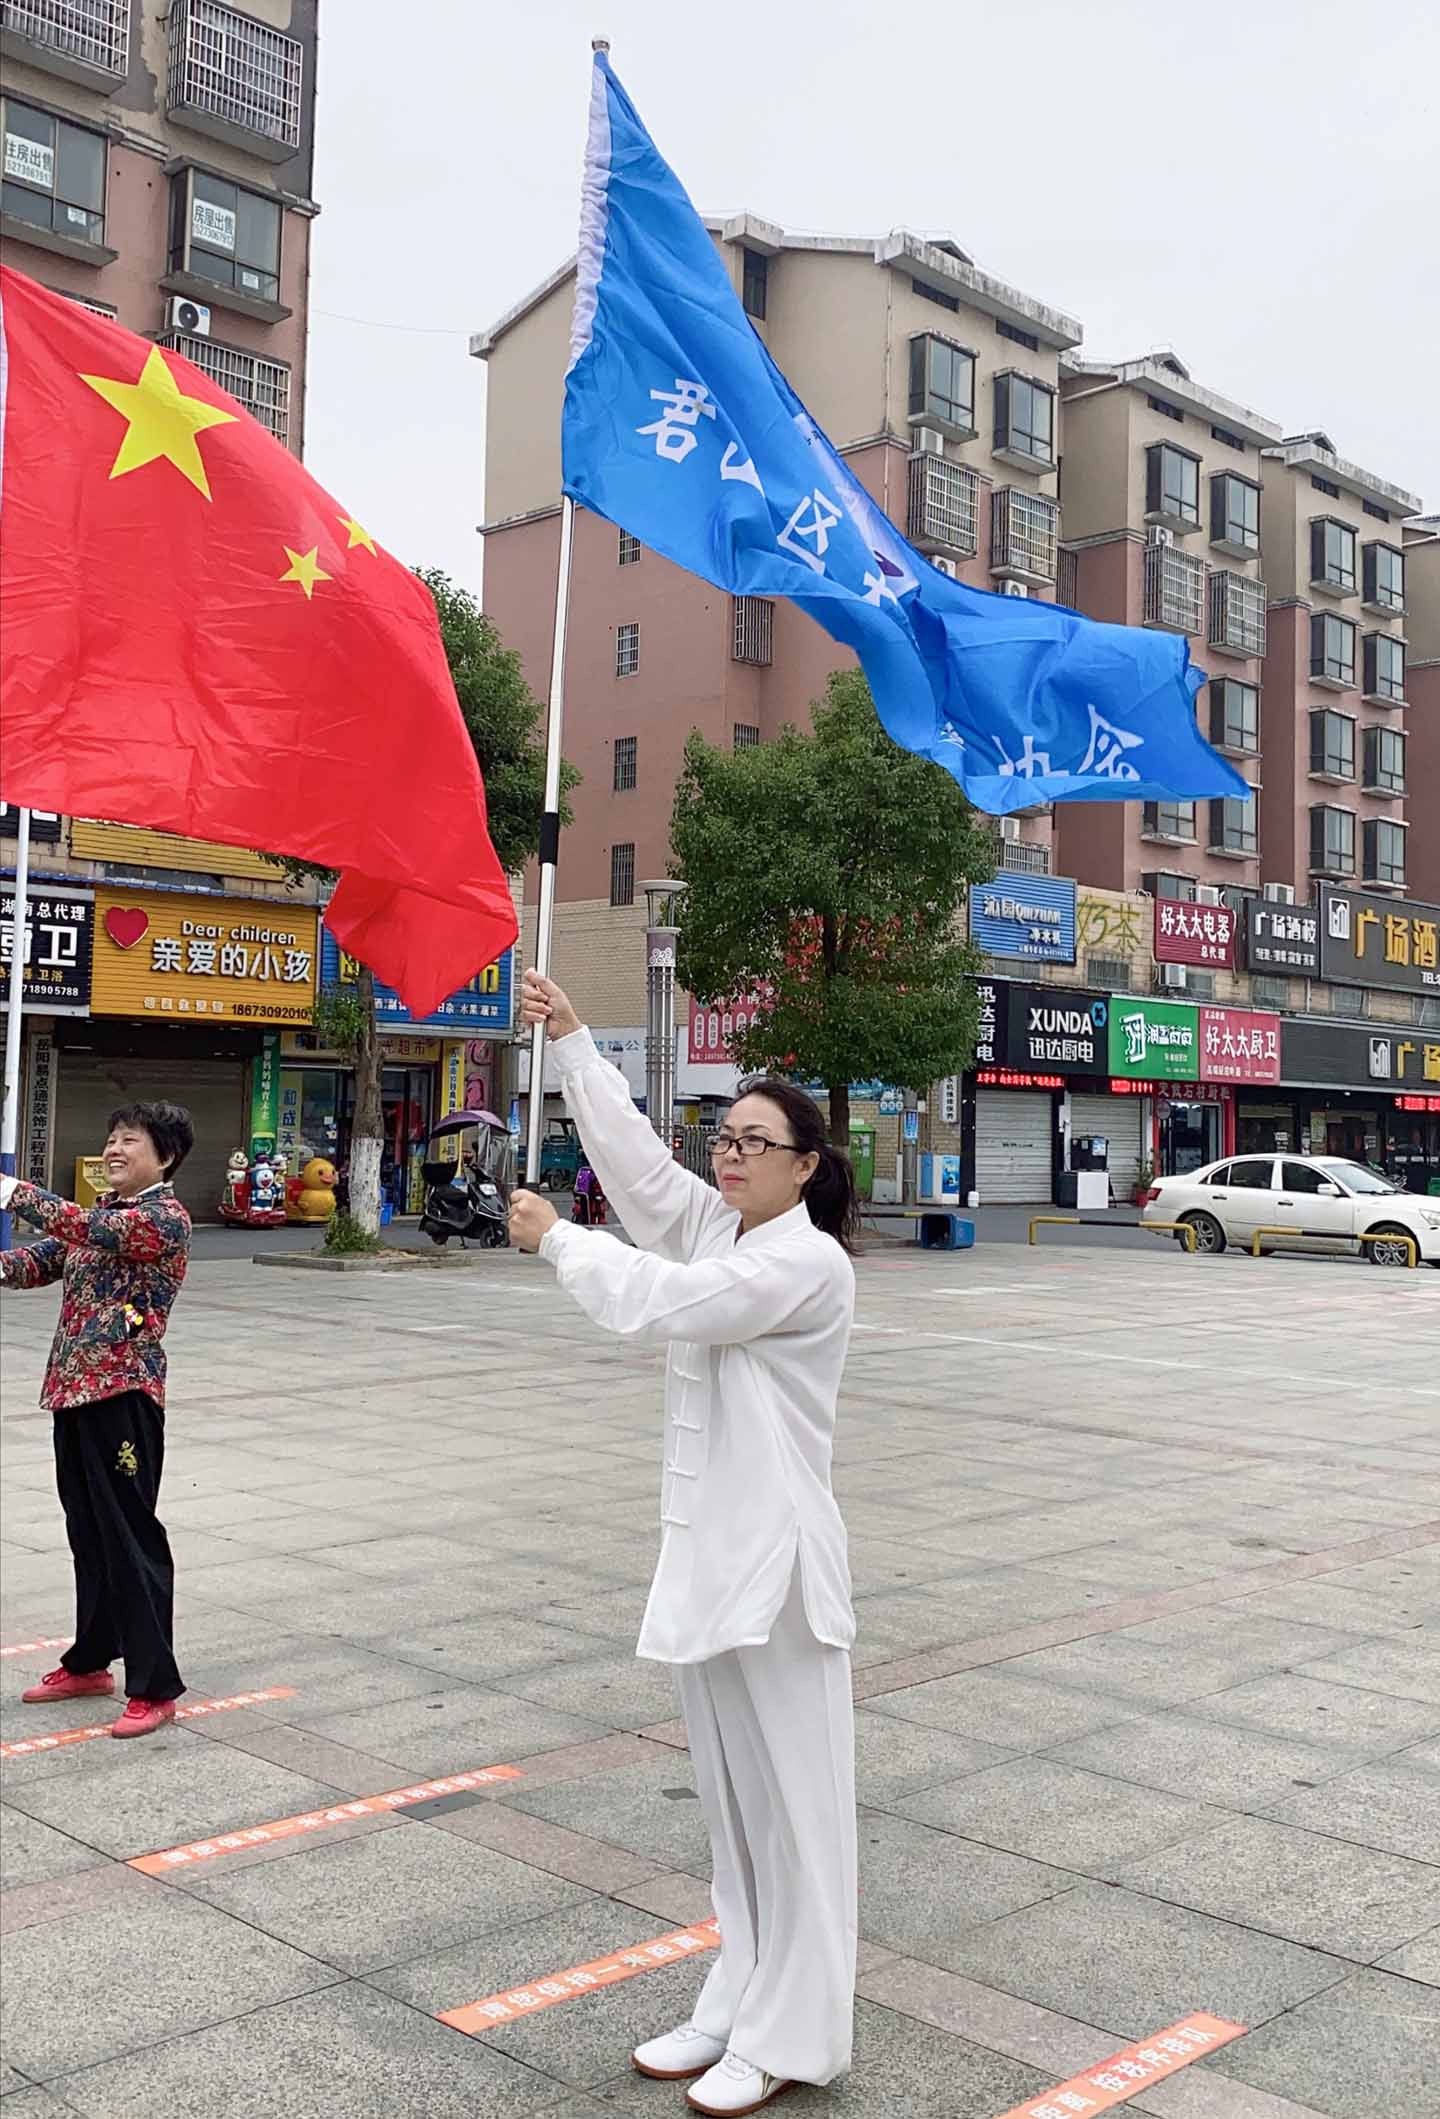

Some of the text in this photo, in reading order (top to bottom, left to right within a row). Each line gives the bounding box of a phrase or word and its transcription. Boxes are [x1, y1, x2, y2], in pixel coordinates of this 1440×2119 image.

[194, 206, 233, 234] 房屋出售
[181, 920, 297, 945] Dear children
[1160, 905, 1231, 944] 好太太电器
[152, 938, 312, 982] 亲爱的小孩
[1201, 945, 1227, 961] 总代理
[232, 1003, 308, 1020] 18673092010
[976, 986, 997, 1062] 迅达厨电
[1029, 1007, 1093, 1036] XUNDA
[1029, 1037, 1094, 1063] 迅达厨电
[1206, 1024, 1278, 1060] 好太太厨卫
